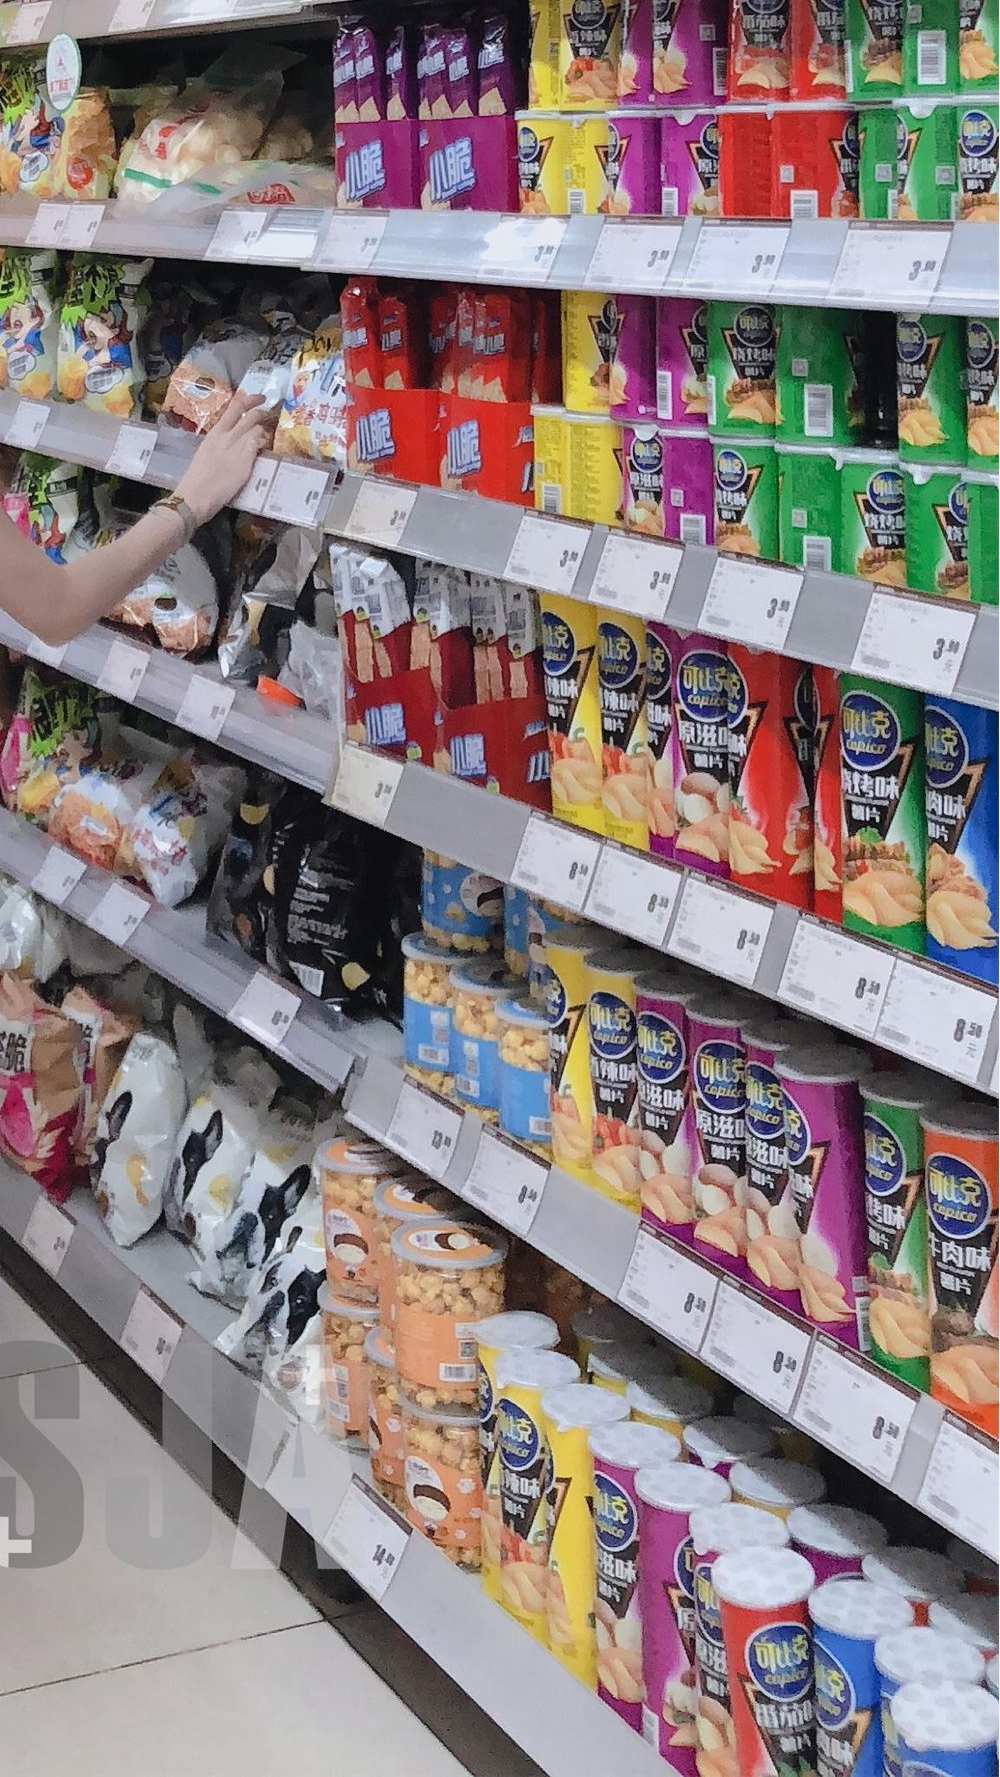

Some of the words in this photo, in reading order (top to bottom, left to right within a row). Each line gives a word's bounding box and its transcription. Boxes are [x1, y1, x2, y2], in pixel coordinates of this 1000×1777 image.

[345, 139, 385, 201] 小脆
[429, 137, 476, 203] 小脆
[356, 408, 395, 463] 小脆
[447, 420, 482, 478] 小脆
[544, 675, 579, 699] 辣味
[600, 688, 640, 713] 辣味
[842, 706, 892, 740] 可比克
[590, 1003, 633, 1032] 可比克
[638, 1025, 678, 1057] 可比克
[700, 1054, 747, 1085] 可比克
[749, 1137, 789, 1170] 滋味
[928, 1167, 982, 1207] 可比克
[866, 1192, 906, 1230] 烤味
[939, 1271, 972, 1296] 薯片
[503, 1472, 541, 1499] 辣味
[598, 1550, 638, 1584] 滋味
[755, 1634, 809, 1674] 可比克
